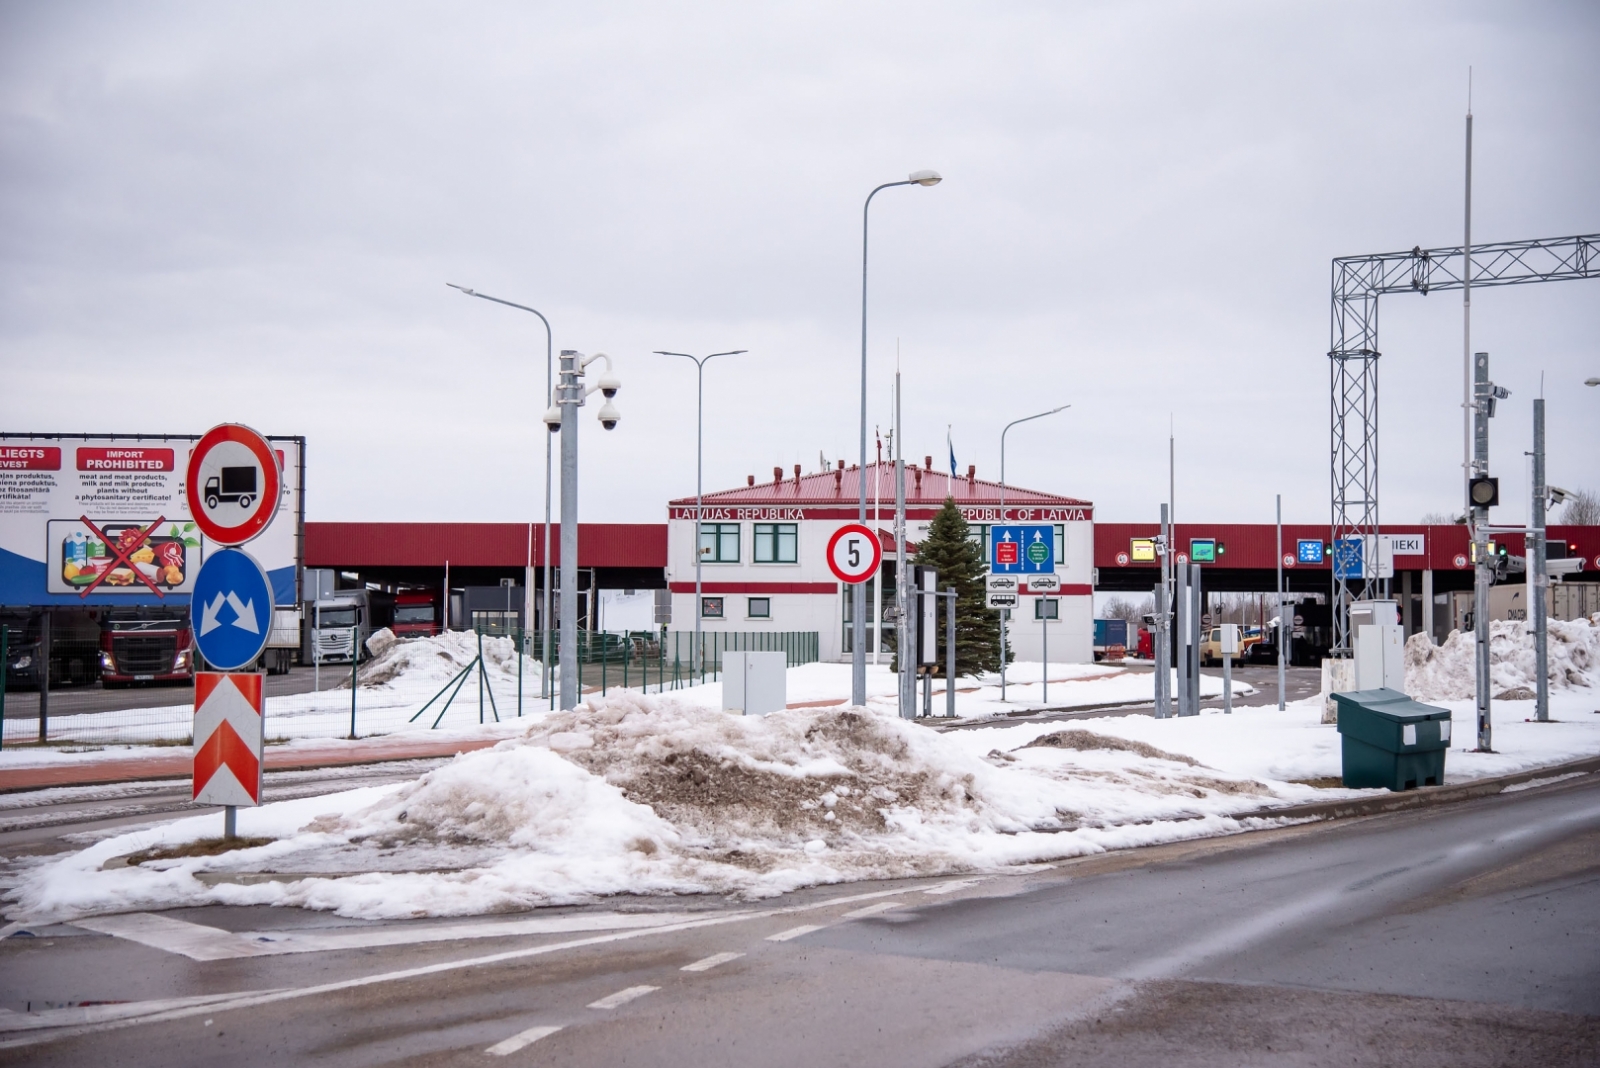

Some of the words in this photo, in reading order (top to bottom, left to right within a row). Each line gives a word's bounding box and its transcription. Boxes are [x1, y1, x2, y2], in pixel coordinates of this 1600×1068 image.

[86, 460, 164, 469] PROHIBITED
[676, 508, 731, 519] LATVIJAS
[737, 508, 805, 520] REPUBLIKA
[960, 509, 1012, 520] EPUBLC
[1017, 509, 1035, 520] OF
[1042, 509, 1085, 520] LATVIA
[1392, 540, 1418, 550] IEKI
[848, 540, 860, 567] 5
